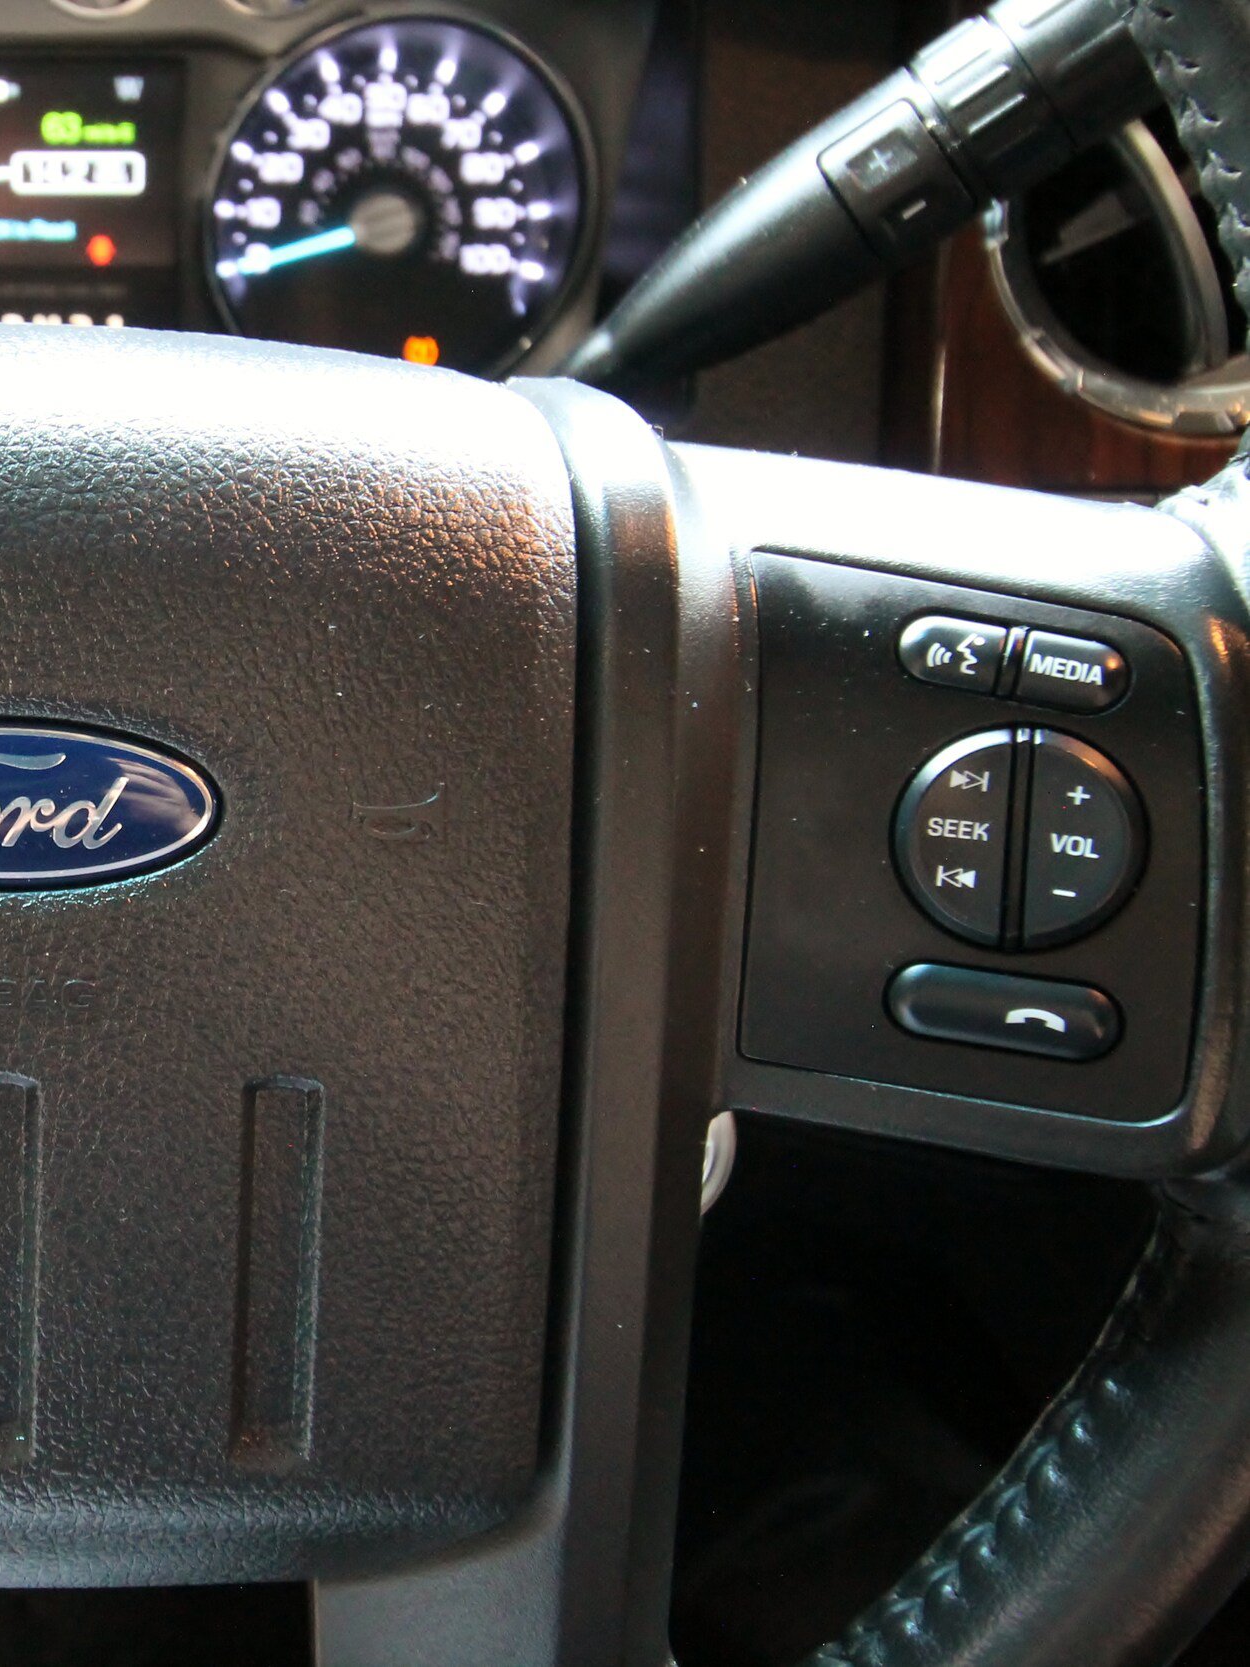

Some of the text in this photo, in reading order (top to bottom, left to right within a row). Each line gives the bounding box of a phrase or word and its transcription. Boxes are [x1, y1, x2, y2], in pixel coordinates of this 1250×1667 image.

[1029, 653, 1104, 686] MEDIA
[927, 816, 989, 842] SEEK
[1050, 833, 1100, 859] VOL
